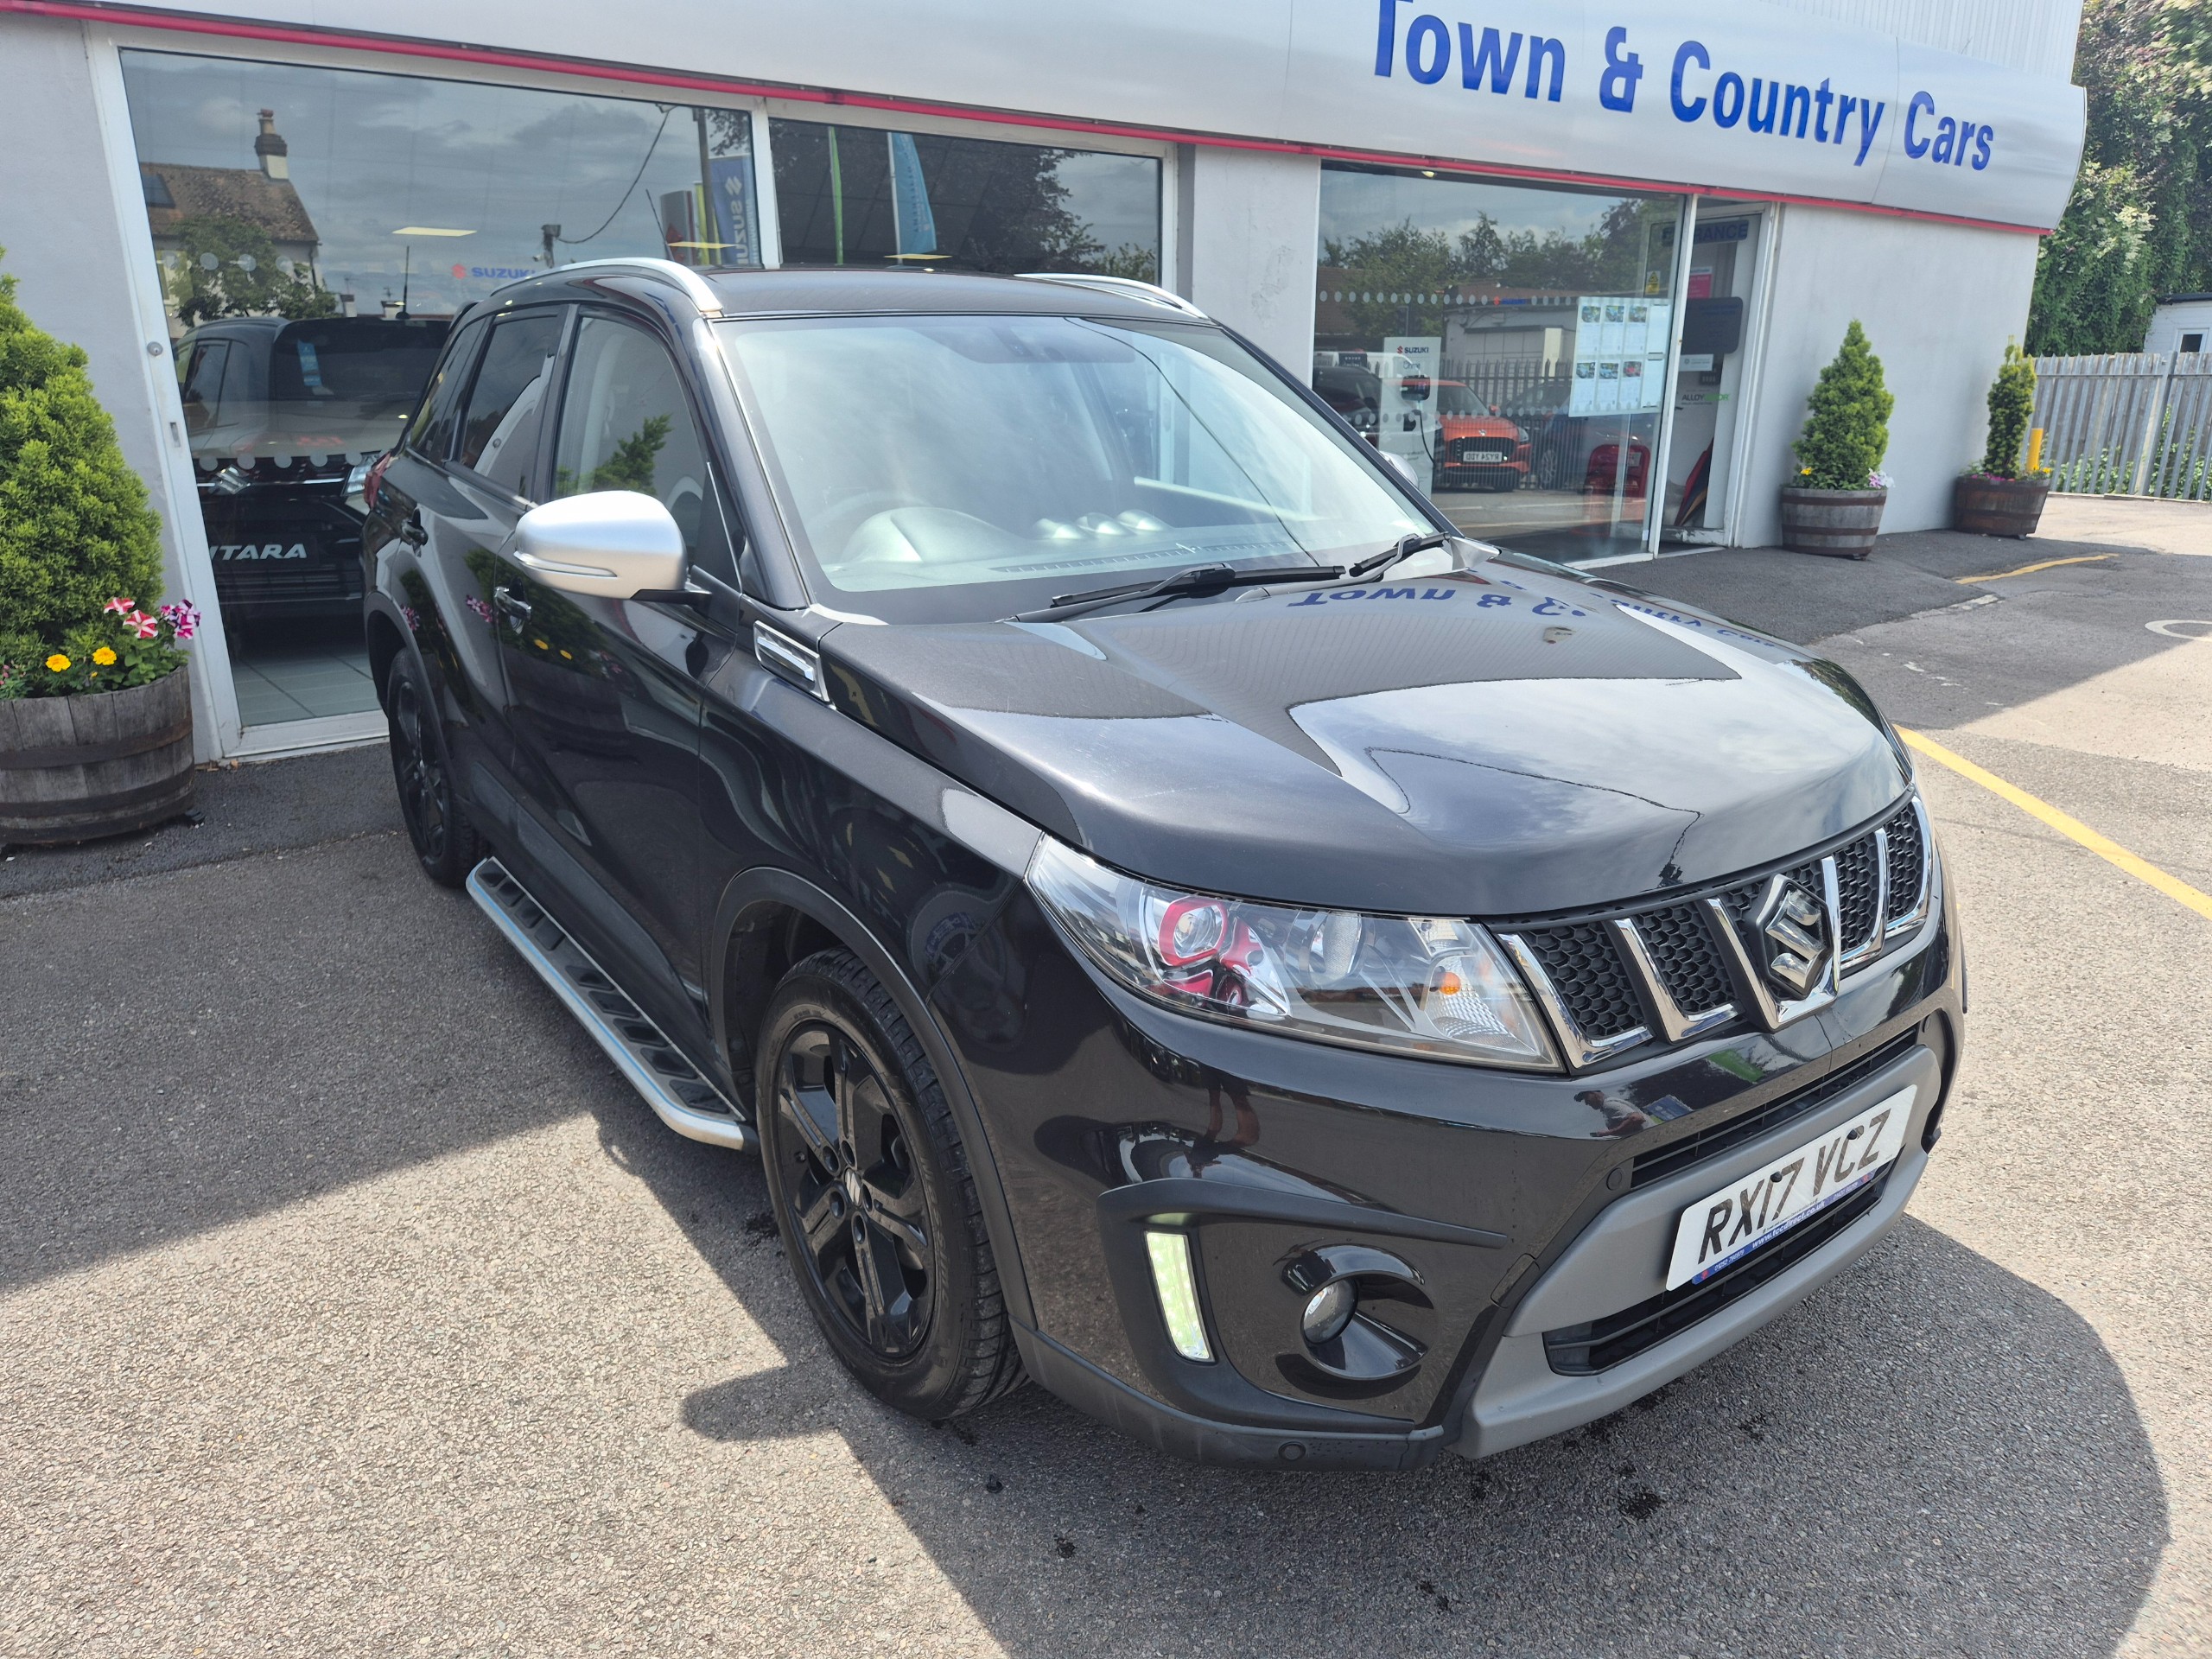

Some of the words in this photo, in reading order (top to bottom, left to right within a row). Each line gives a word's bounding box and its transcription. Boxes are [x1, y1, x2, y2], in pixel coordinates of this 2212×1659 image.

[1374, 0, 1566, 103] Town
[1599, 26, 1643, 113] &
[1669, 40, 1886, 167] Country
[1904, 91, 1994, 171] Cars
[209, 543, 308, 561] ITARA
[1697, 1157, 1805, 1265] RX17
[1812, 1108, 1891, 1198] VCZ
